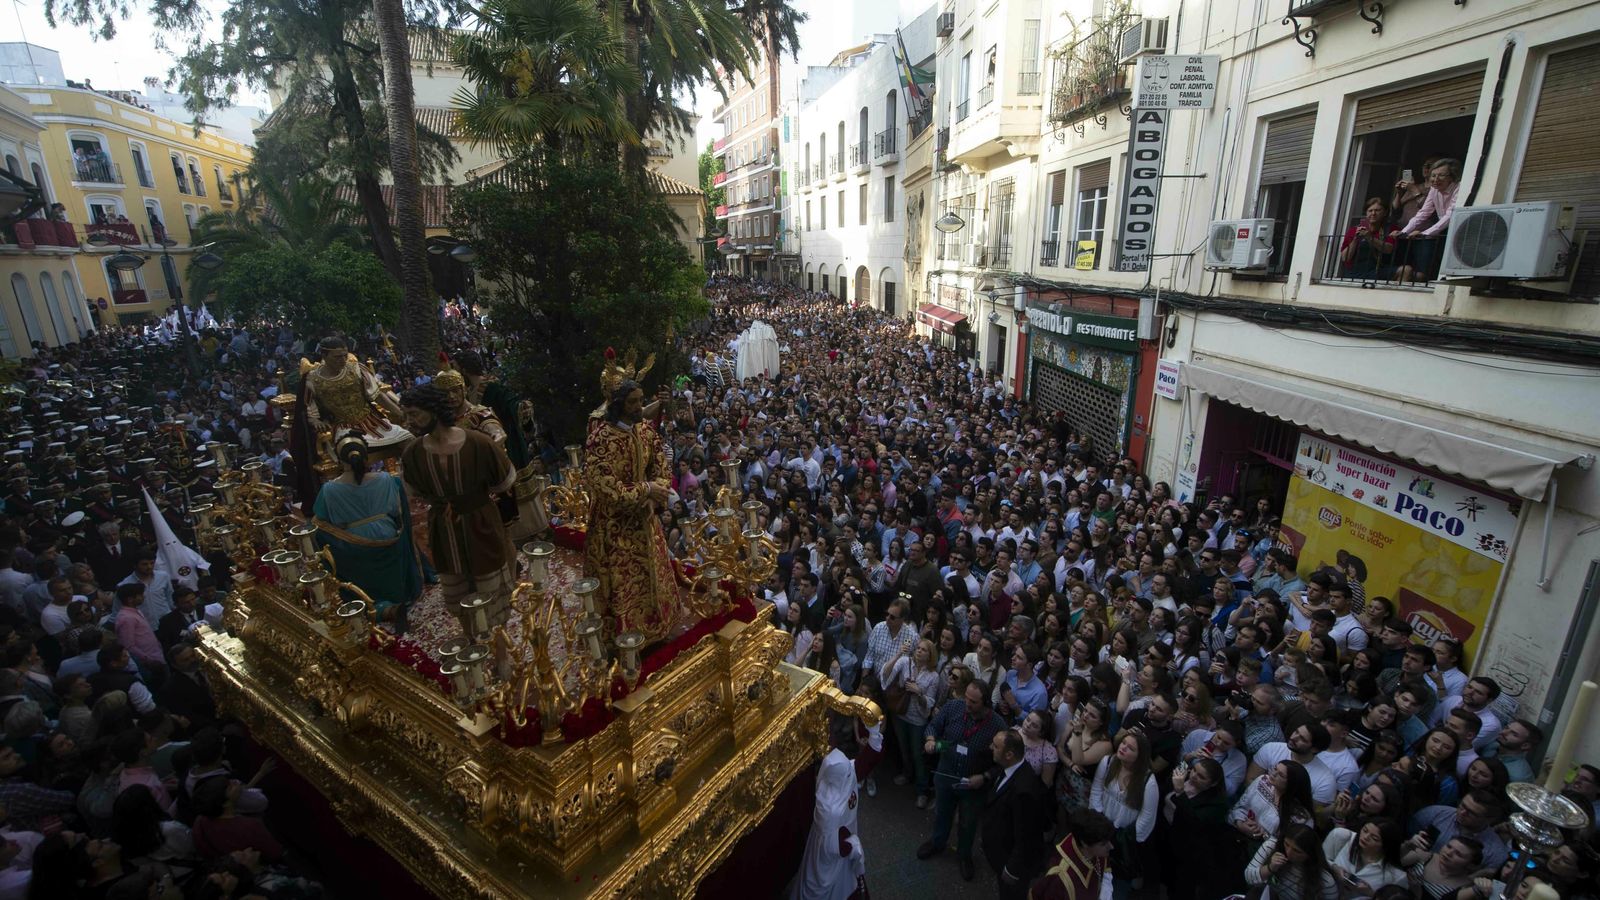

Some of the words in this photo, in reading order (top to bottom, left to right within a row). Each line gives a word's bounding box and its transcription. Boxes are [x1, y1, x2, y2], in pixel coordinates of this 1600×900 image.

[1124, 111, 1164, 251] ABOGADOS
[1121, 253, 1140, 262] Portal
[1076, 322, 1136, 341] RESTAURANTE
[1158, 371, 1176, 385] Paco
[1335, 462, 1361, 482] Super
[1362, 473, 1392, 491] bazar
[1336, 447, 1397, 478] Alimentación
[1393, 491, 1465, 537] Paco
[1344, 516, 1368, 532] Ponte
[1369, 527, 1394, 545] sabor
[1366, 536, 1384, 549] vida
